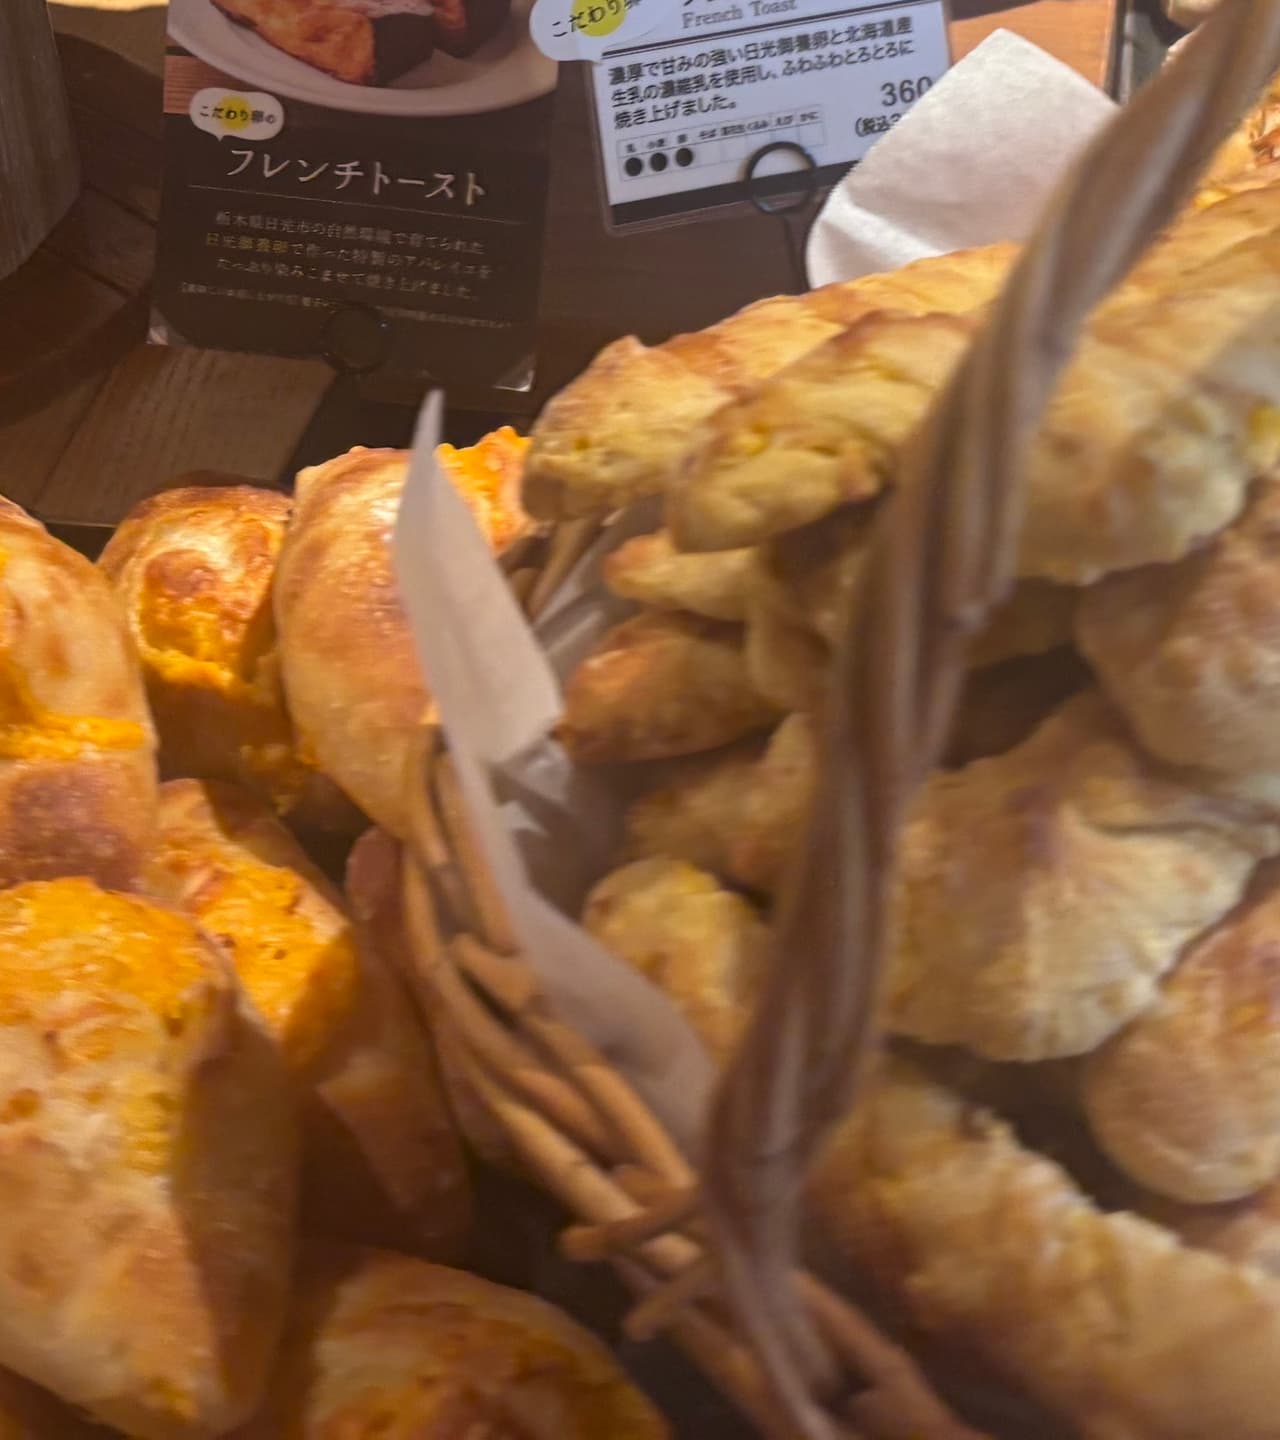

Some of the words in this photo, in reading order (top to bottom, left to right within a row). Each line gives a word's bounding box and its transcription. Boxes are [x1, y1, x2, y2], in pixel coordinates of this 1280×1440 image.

[682, 3, 744, 30] French
[614, 96, 737, 131] 焼き上げました。
[226, 149, 487, 206] フレンチトースト
